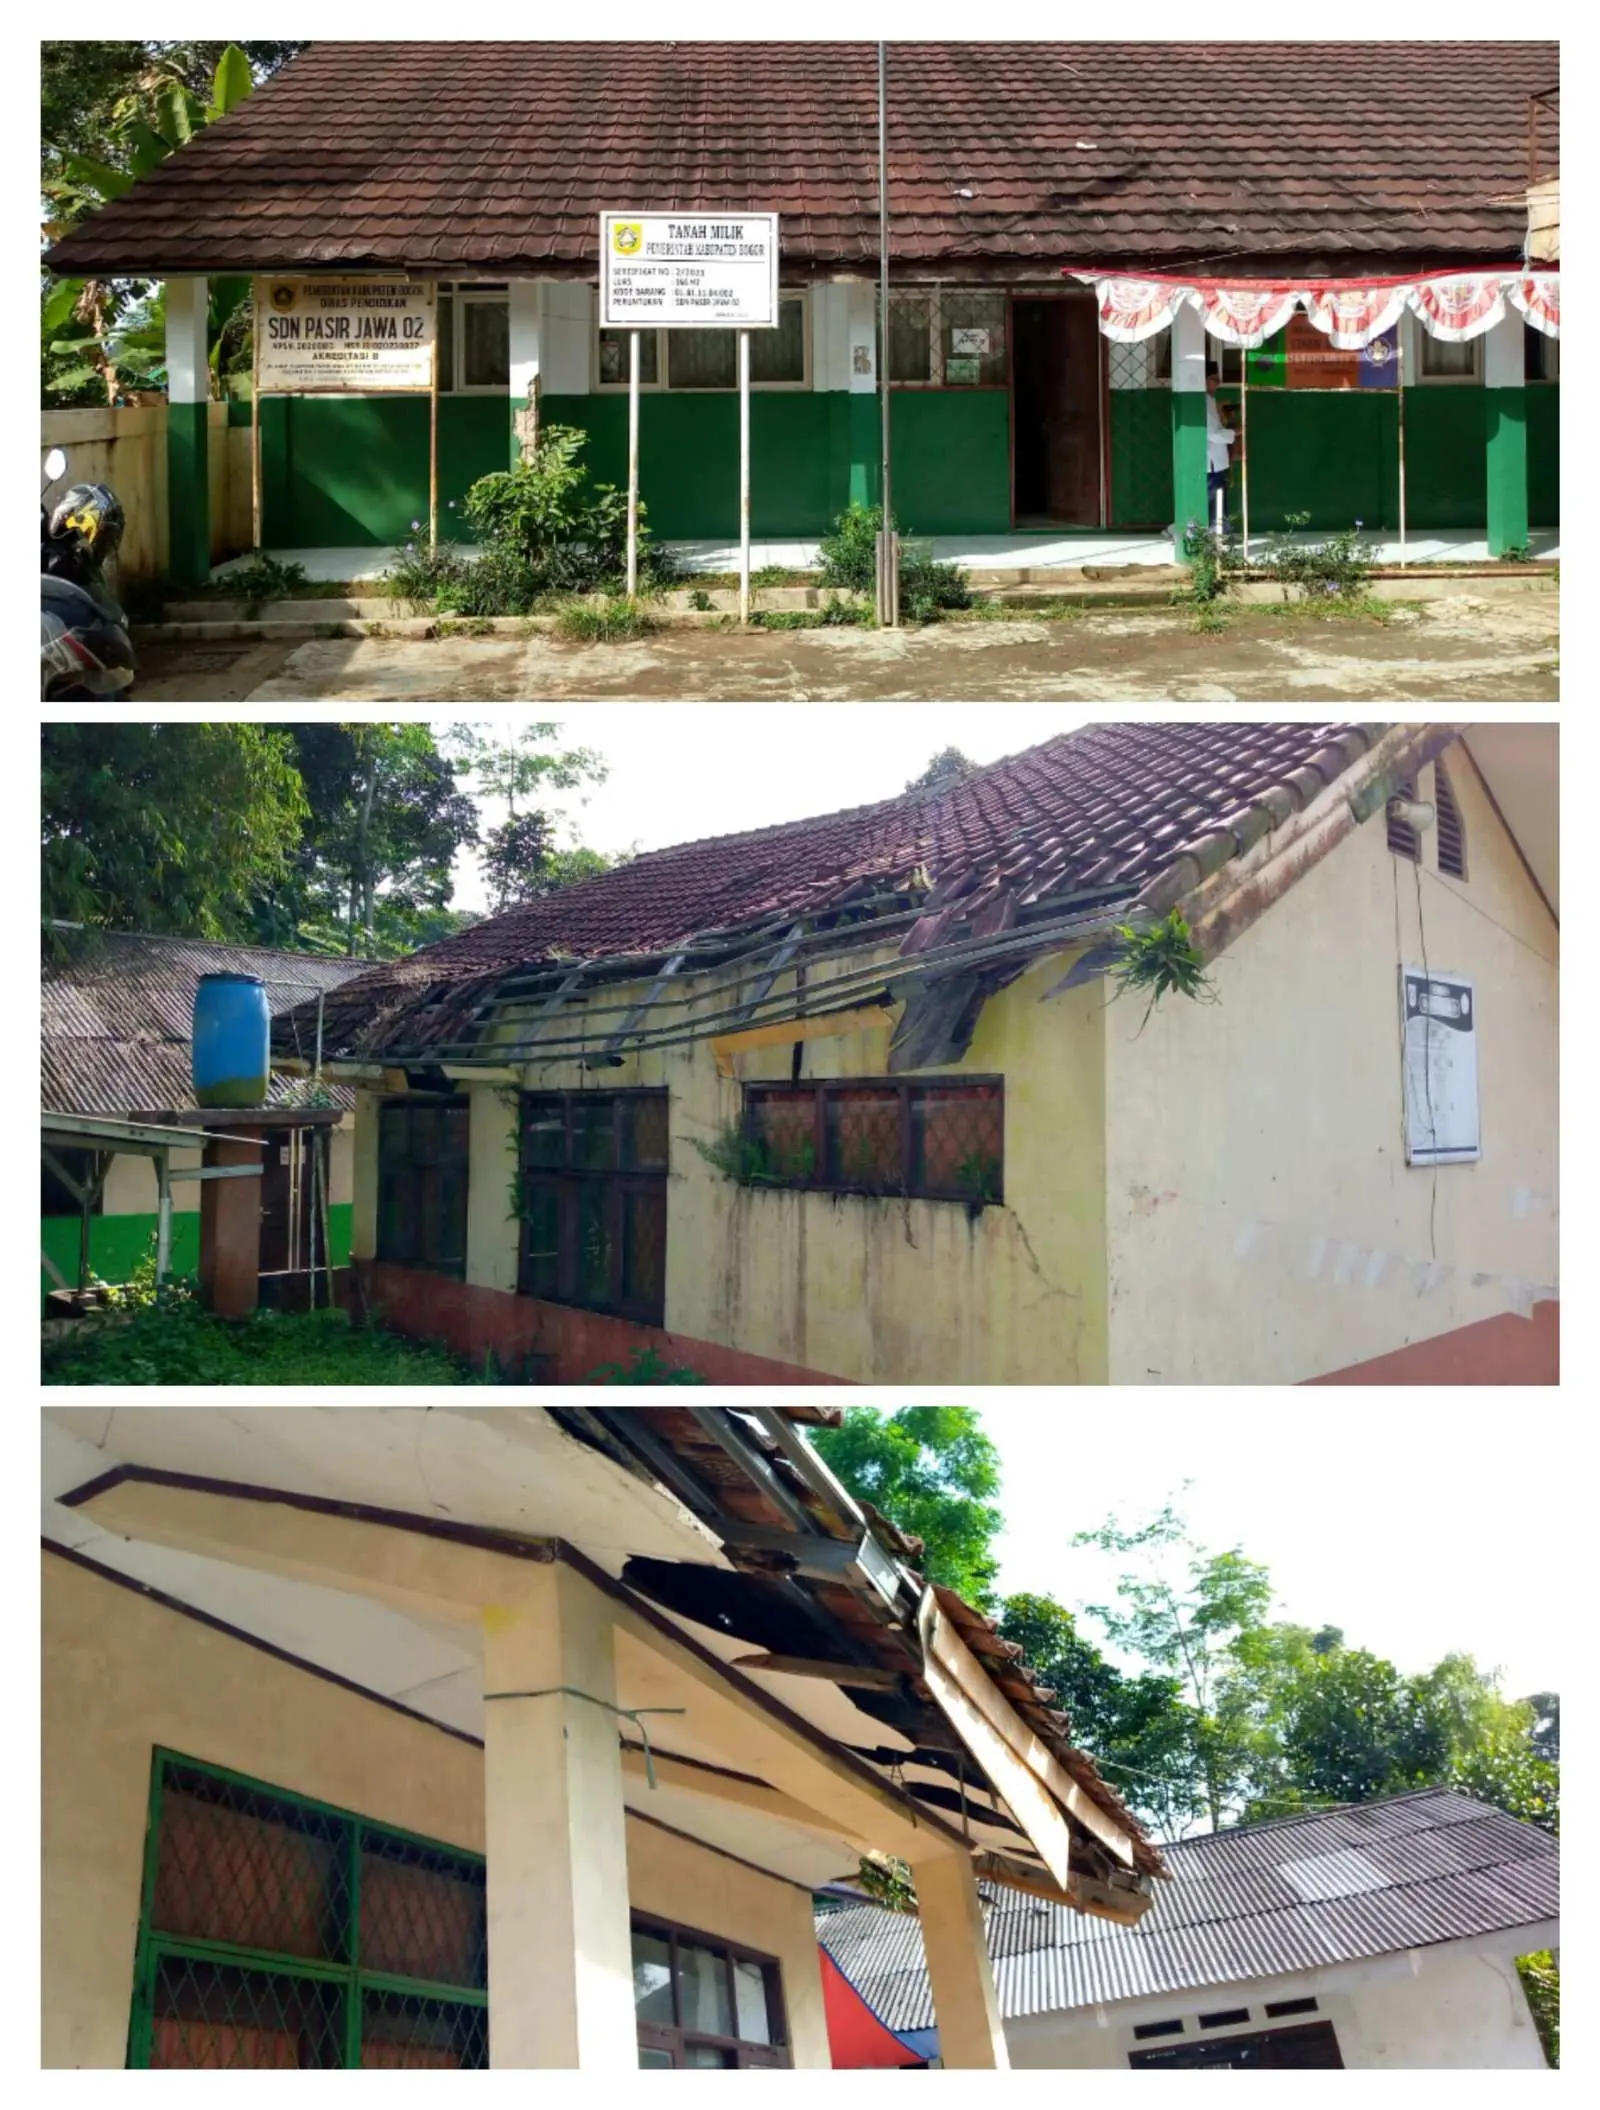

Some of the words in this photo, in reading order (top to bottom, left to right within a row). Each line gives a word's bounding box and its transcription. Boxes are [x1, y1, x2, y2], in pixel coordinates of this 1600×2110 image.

[668, 224, 707, 239] TANAH
[710, 225, 744, 240] MILIK
[320, 298, 348, 308] DINAS
[351, 298, 407, 308] PENDIDIKAN
[268, 316, 300, 339] SDN
[305, 316, 350, 339] PASIR
[354, 316, 398, 339] JAWA
[403, 316, 425, 339] 02
[312, 352, 369, 360] AKREDITASI
